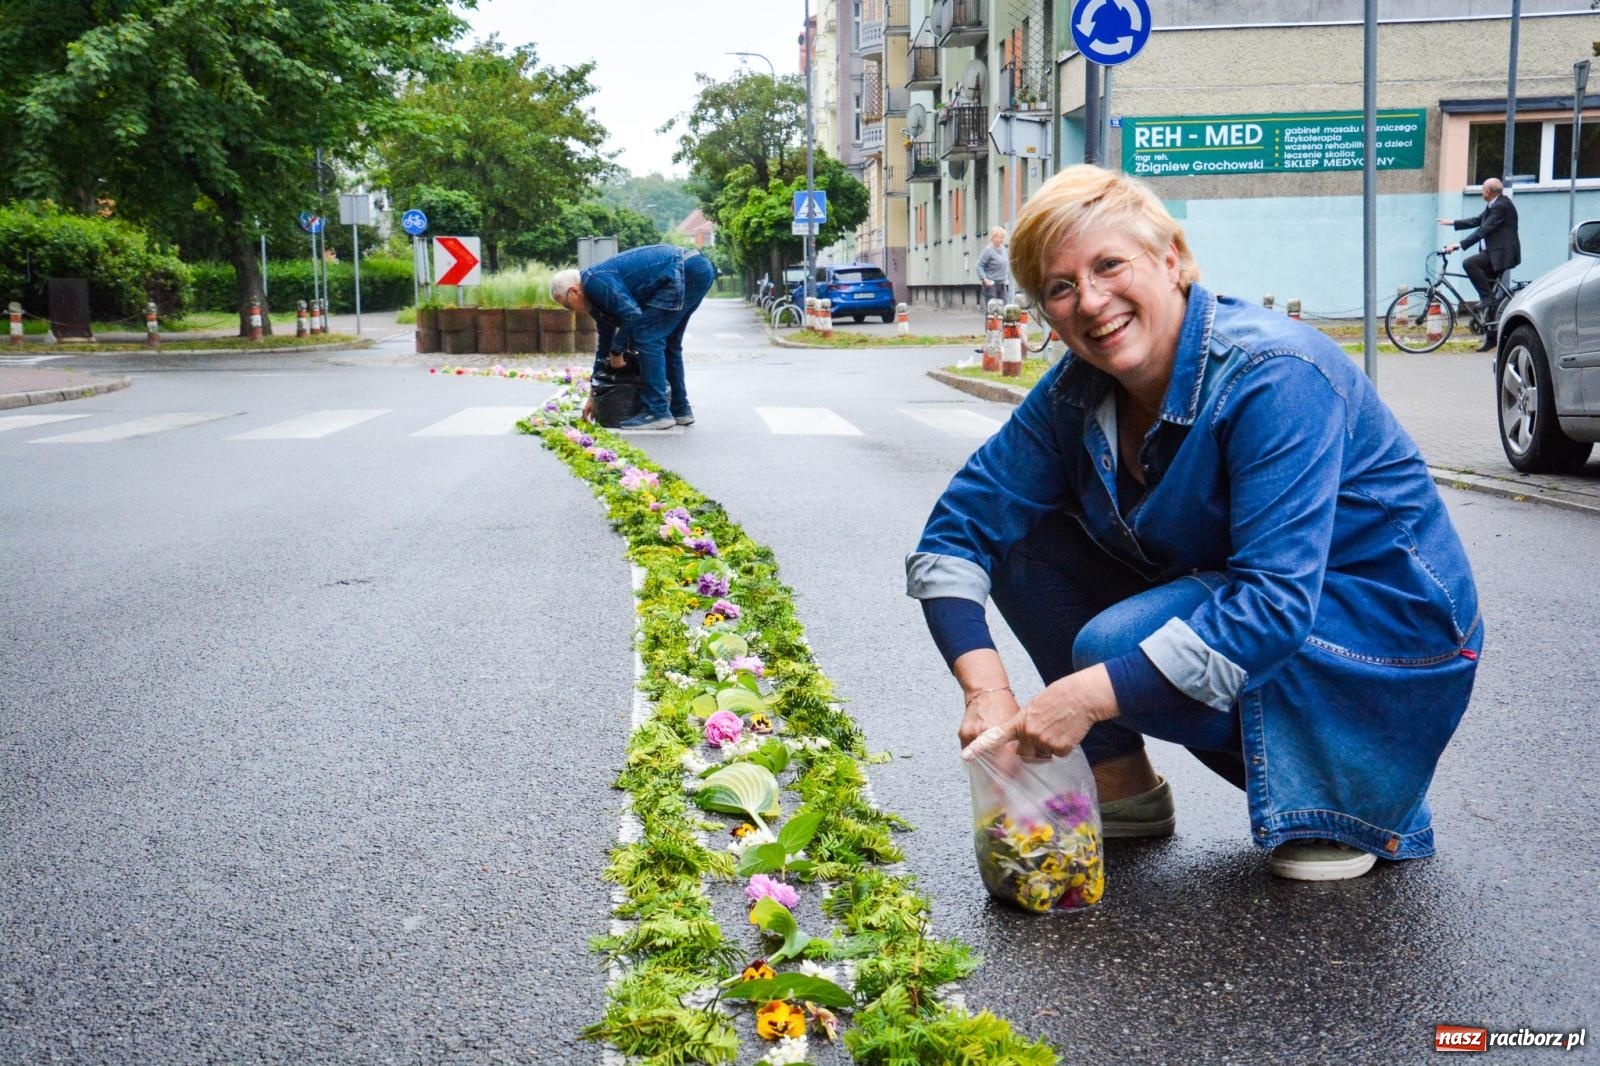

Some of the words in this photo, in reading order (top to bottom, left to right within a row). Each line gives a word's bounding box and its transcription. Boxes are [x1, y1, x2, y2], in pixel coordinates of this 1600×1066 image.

[1284, 126, 1320, 135] gabinet
[1323, 125, 1360, 133] masażu
[1361, 124, 1418, 132] lzniczego
[1135, 126, 1182, 148] REH
[1205, 124, 1263, 146] MED
[1284, 134, 1342, 143] fizykoterapia
[1284, 142, 1323, 151] wczesna
[1384, 140, 1413, 148] dzieci
[1135, 154, 1151, 162] mgr
[1154, 153, 1169, 161] reh.
[1284, 151, 1322, 159] leczenie
[1325, 150, 1356, 158] skolioz
[1135, 161, 1190, 174] Zbigniew
[1192, 159, 1264, 171] Grochowski
[1284, 159, 1319, 168] SKLEP
[1323, 157, 1395, 167] MEDYCNY
